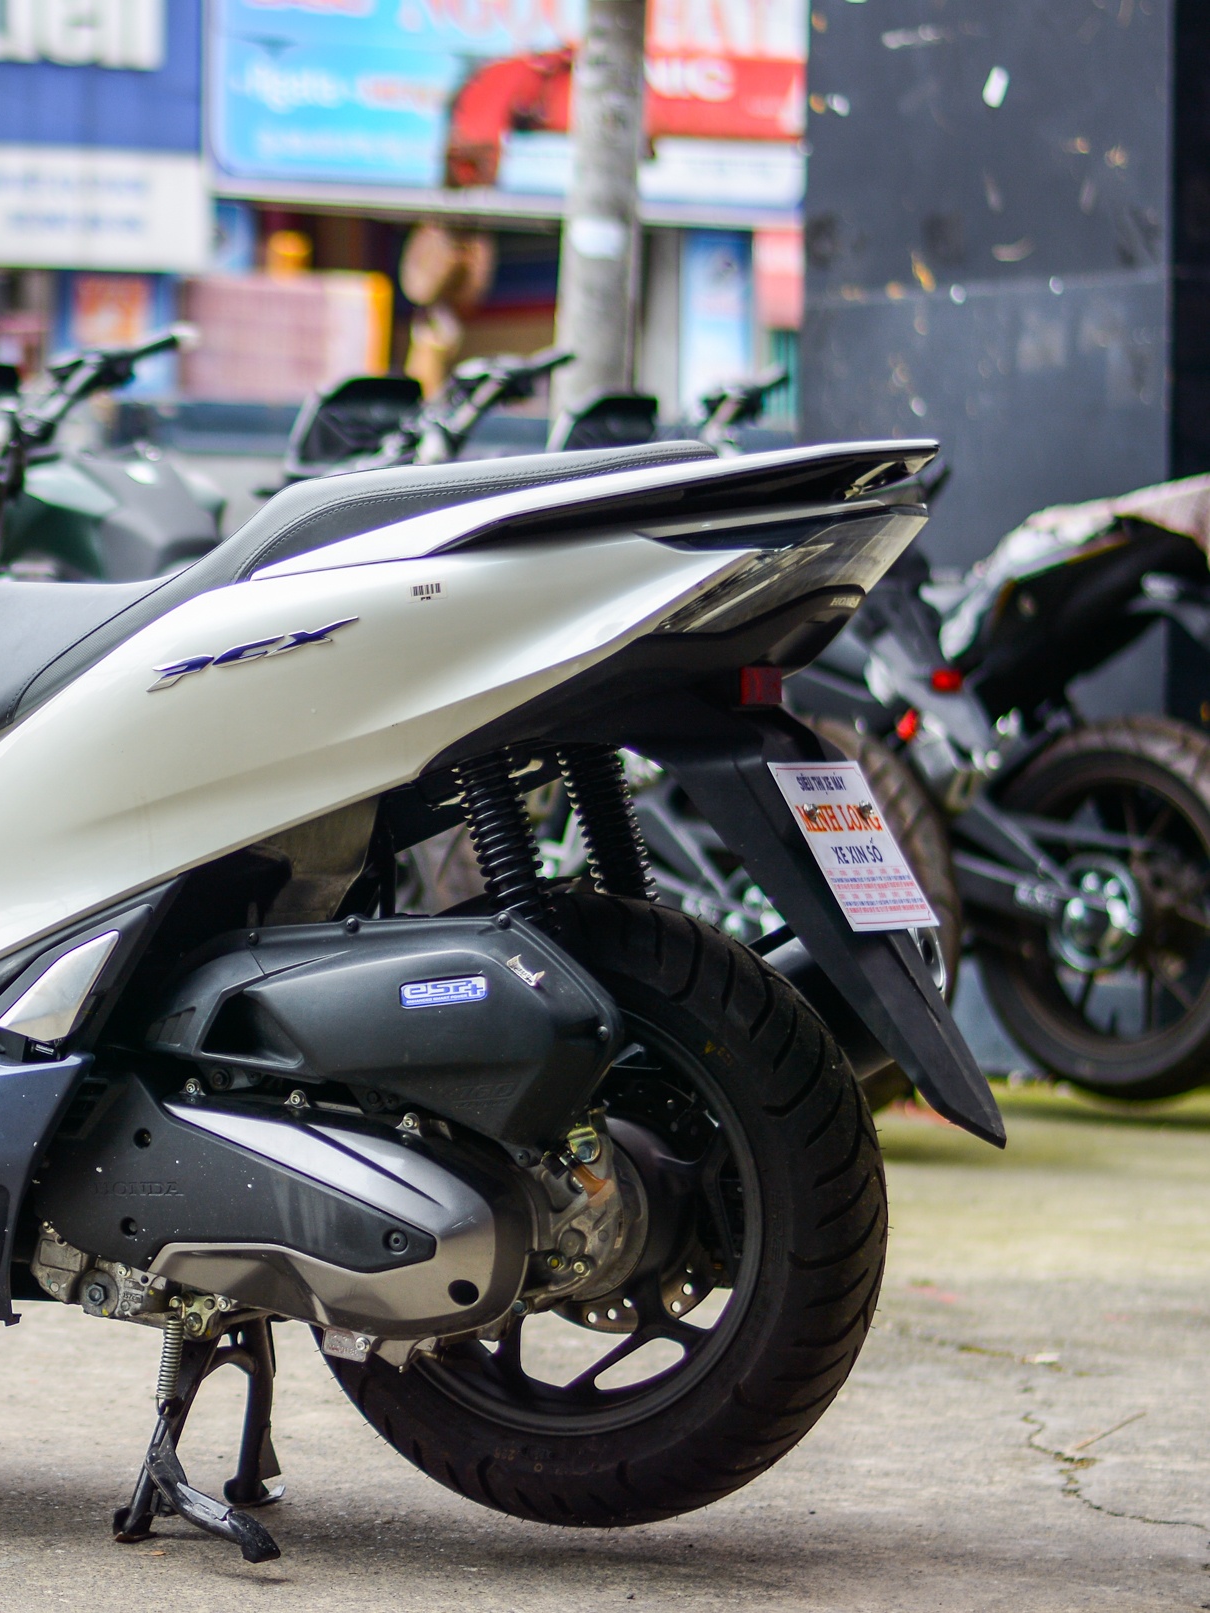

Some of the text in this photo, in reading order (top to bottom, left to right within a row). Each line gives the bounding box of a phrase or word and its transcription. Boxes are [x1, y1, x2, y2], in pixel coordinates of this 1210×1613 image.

[146, 616, 360, 692] PCX
[831, 837, 883, 864] XE XIN SỐ
[93, 1181, 186, 1197] HONDA
